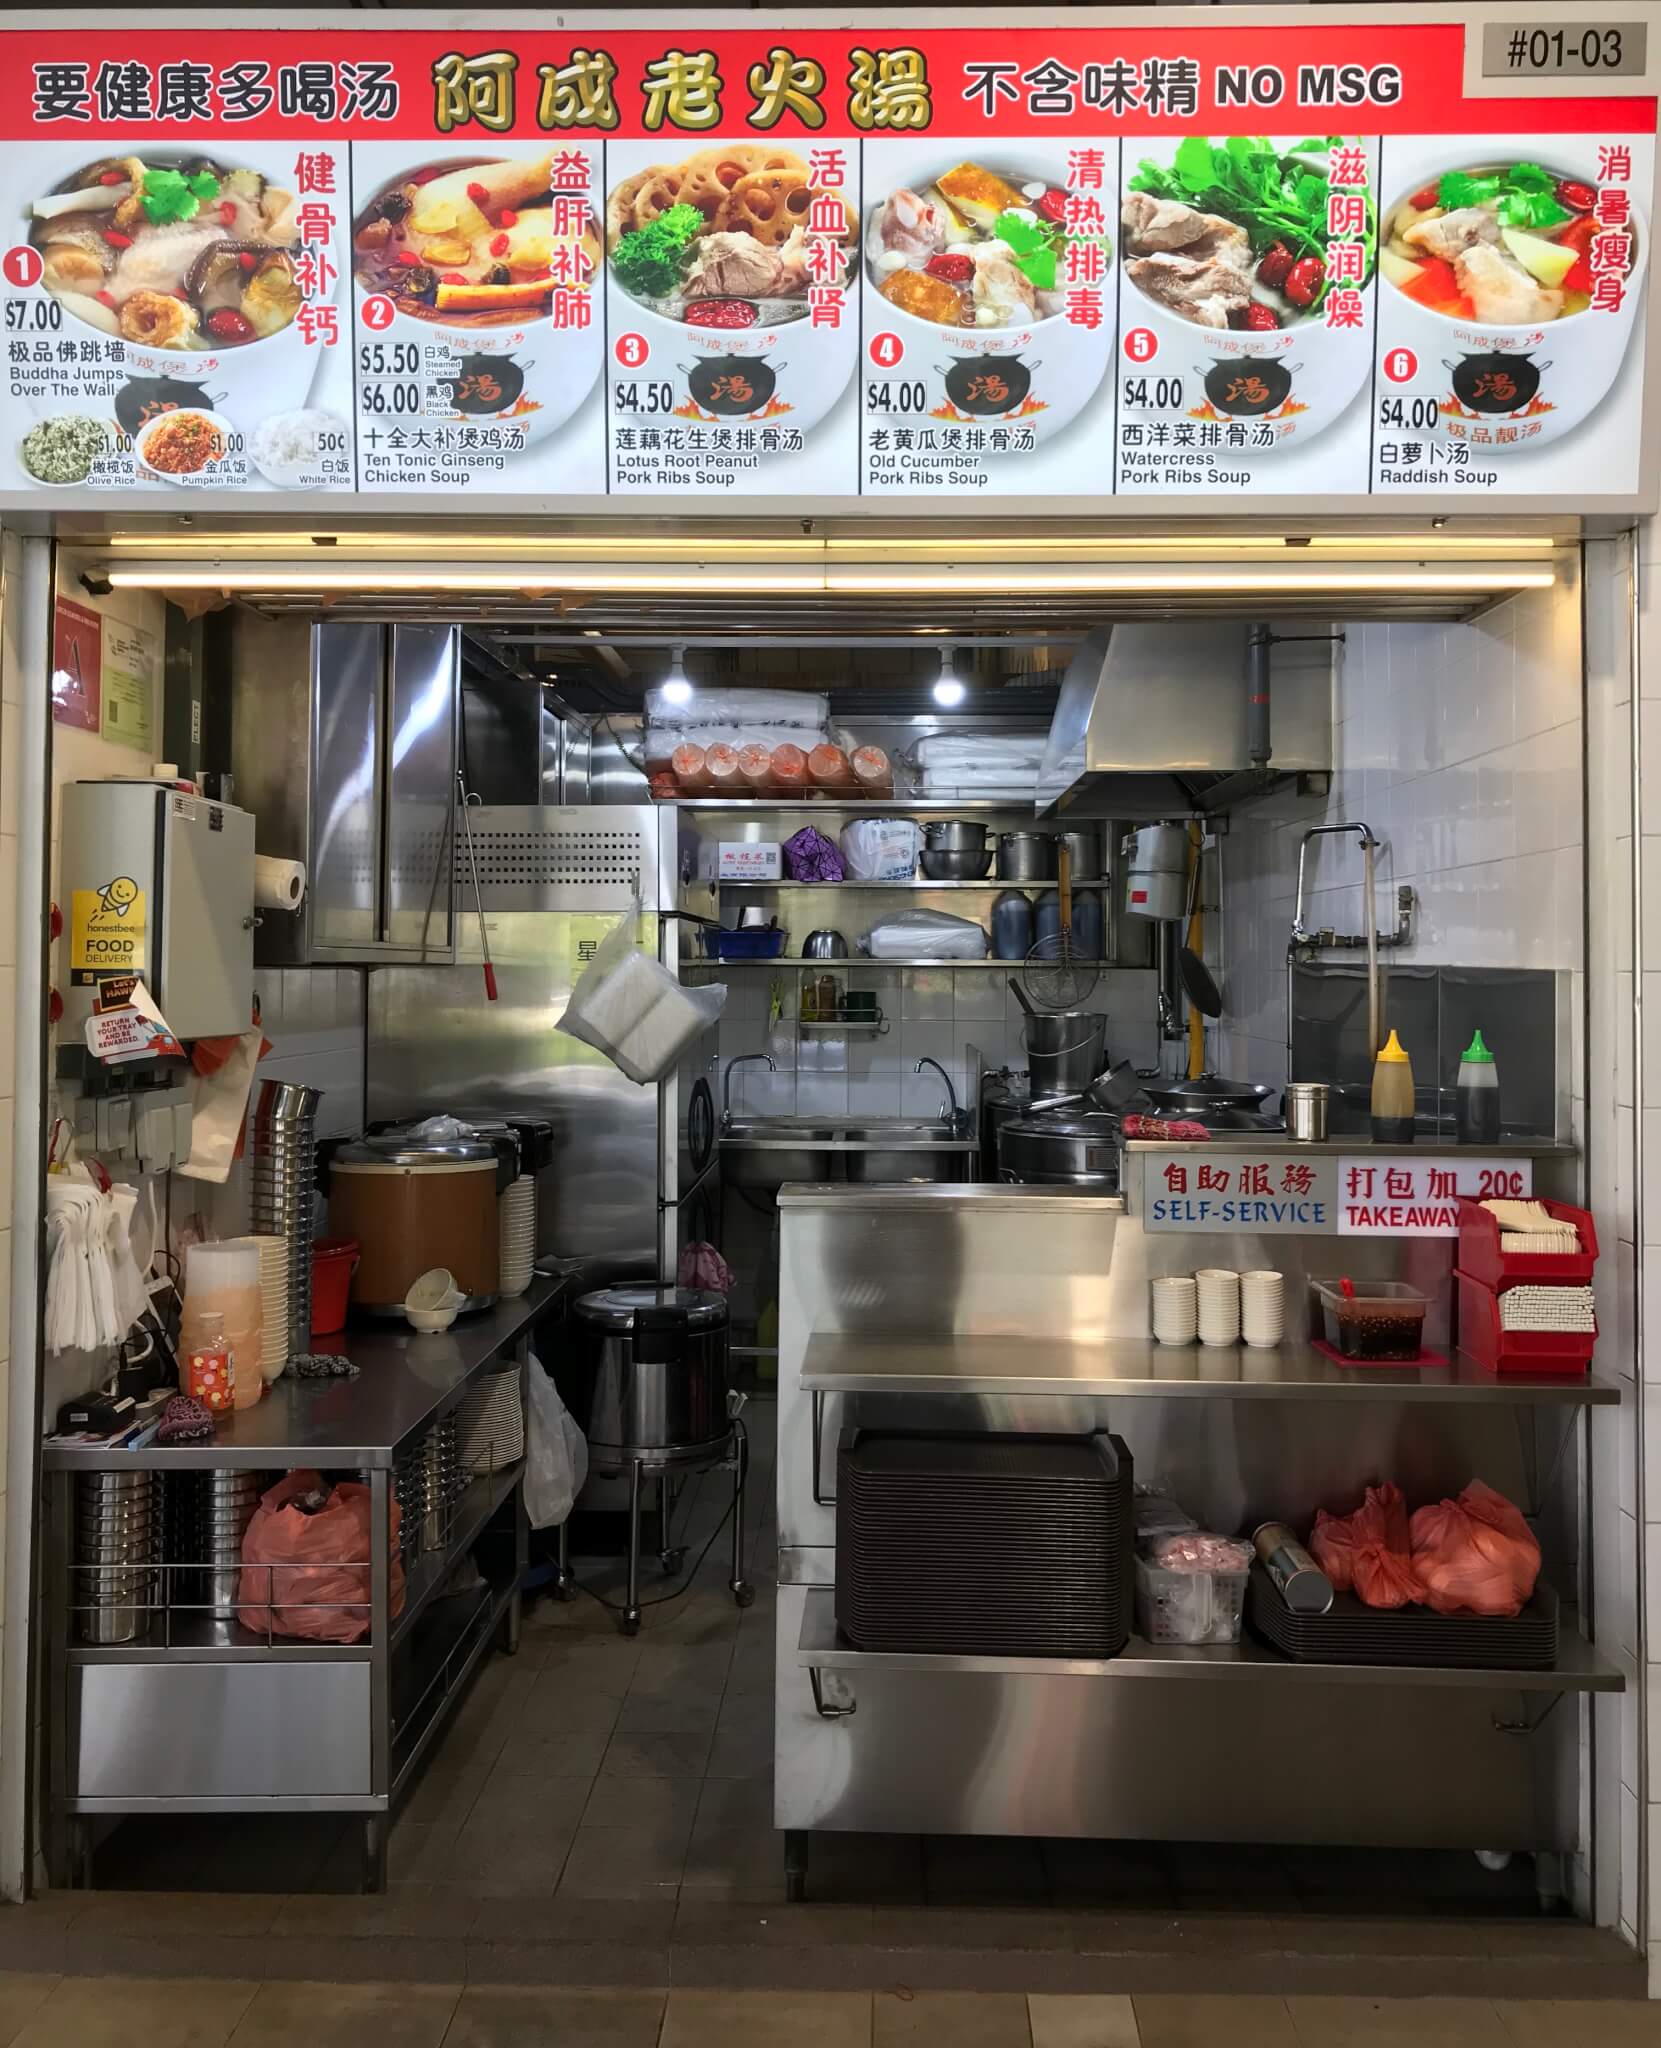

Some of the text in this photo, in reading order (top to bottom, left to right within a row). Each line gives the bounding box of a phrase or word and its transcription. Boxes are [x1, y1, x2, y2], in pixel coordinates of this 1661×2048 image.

[1508, 30, 1623, 68] #01-03
[32, 60, 400, 123] 要健康多喝汤
[963, 58, 1200, 118] 不含味精
[1215, 64, 1402, 107] NO MSG
[1325, 147, 1367, 330] 滋阴润燥
[1592, 145, 1632, 313] 消暑瘦身
[551, 150, 592, 331] 益肝补肺
[808, 149, 847, 329] 活血补肾
[1064, 149, 1106, 330] 清热排毒
[294, 152, 339, 347] 健骨补钙
[6, 299, 61, 331] $7.00
[8, 341, 125, 363] 极品佛跳墙
[361, 343, 419, 375] $5.50
[424, 346, 450, 359] 白鸡
[425, 360, 461, 369] Steamed
[425, 369, 459, 377] Chicken
[10, 367, 124, 385] Buddha Jumps
[11, 383, 116, 397] Over The Wall
[363, 382, 420, 414] $6.00
[425, 385, 452, 399] 黑鸡
[616, 383, 674, 414] $4.50
[868, 382, 926, 413] $4.00
[1125, 378, 1182, 409] $4.00
[426, 400, 449, 409] Black
[426, 408, 460, 417] Chicken
[1380, 398, 1438, 429] $4.00
[98, 434, 132, 453] $1.00
[210, 433, 244, 452] $1.00
[318, 432, 345, 451] 50¢
[363, 427, 525, 450] 十全大补煲鸡汤
[616, 429, 803, 451] 莲藕花生煲排骨汤
[869, 429, 1034, 451] 老黄瓜煲排骨汤
[1121, 422, 1275, 448] 西洋菜排骨汤
[365, 454, 505, 470] Ten Tonic Ginseng
[617, 455, 758, 468] Lotus Root Peanut
[870, 455, 979, 468] Old Cucumber
[1121, 452, 1215, 466] Watercress
[1380, 442, 1469, 464] 白萝卜汤
[205, 460, 247, 474] 金瓜饭
[321, 459, 349, 473] 白饭
[87, 476, 136, 486] Olive Rice
[182, 476, 248, 489] Pumpkin Rice
[299, 475, 351, 486] White Rice
[365, 470, 470, 487] Chicken Soup
[617, 471, 735, 487] Pork Ribs Soup
[870, 471, 988, 489] Pork Ribs Soup
[1121, 470, 1251, 487] Pork Ribs Soup
[1381, 470, 1497, 487] Raddish Soup
[87, 923, 135, 933] honestbee
[87, 940, 134, 952] FOOD
[86, 955, 133, 963] DELIVERY
[1163, 1162, 1317, 1196] 自助服務
[1346, 1167, 1524, 1200] 打包加 20¢
[1153, 1200, 1327, 1224] SELF-SERVICE
[1347, 1205, 1463, 1228] TAKEAWAY
